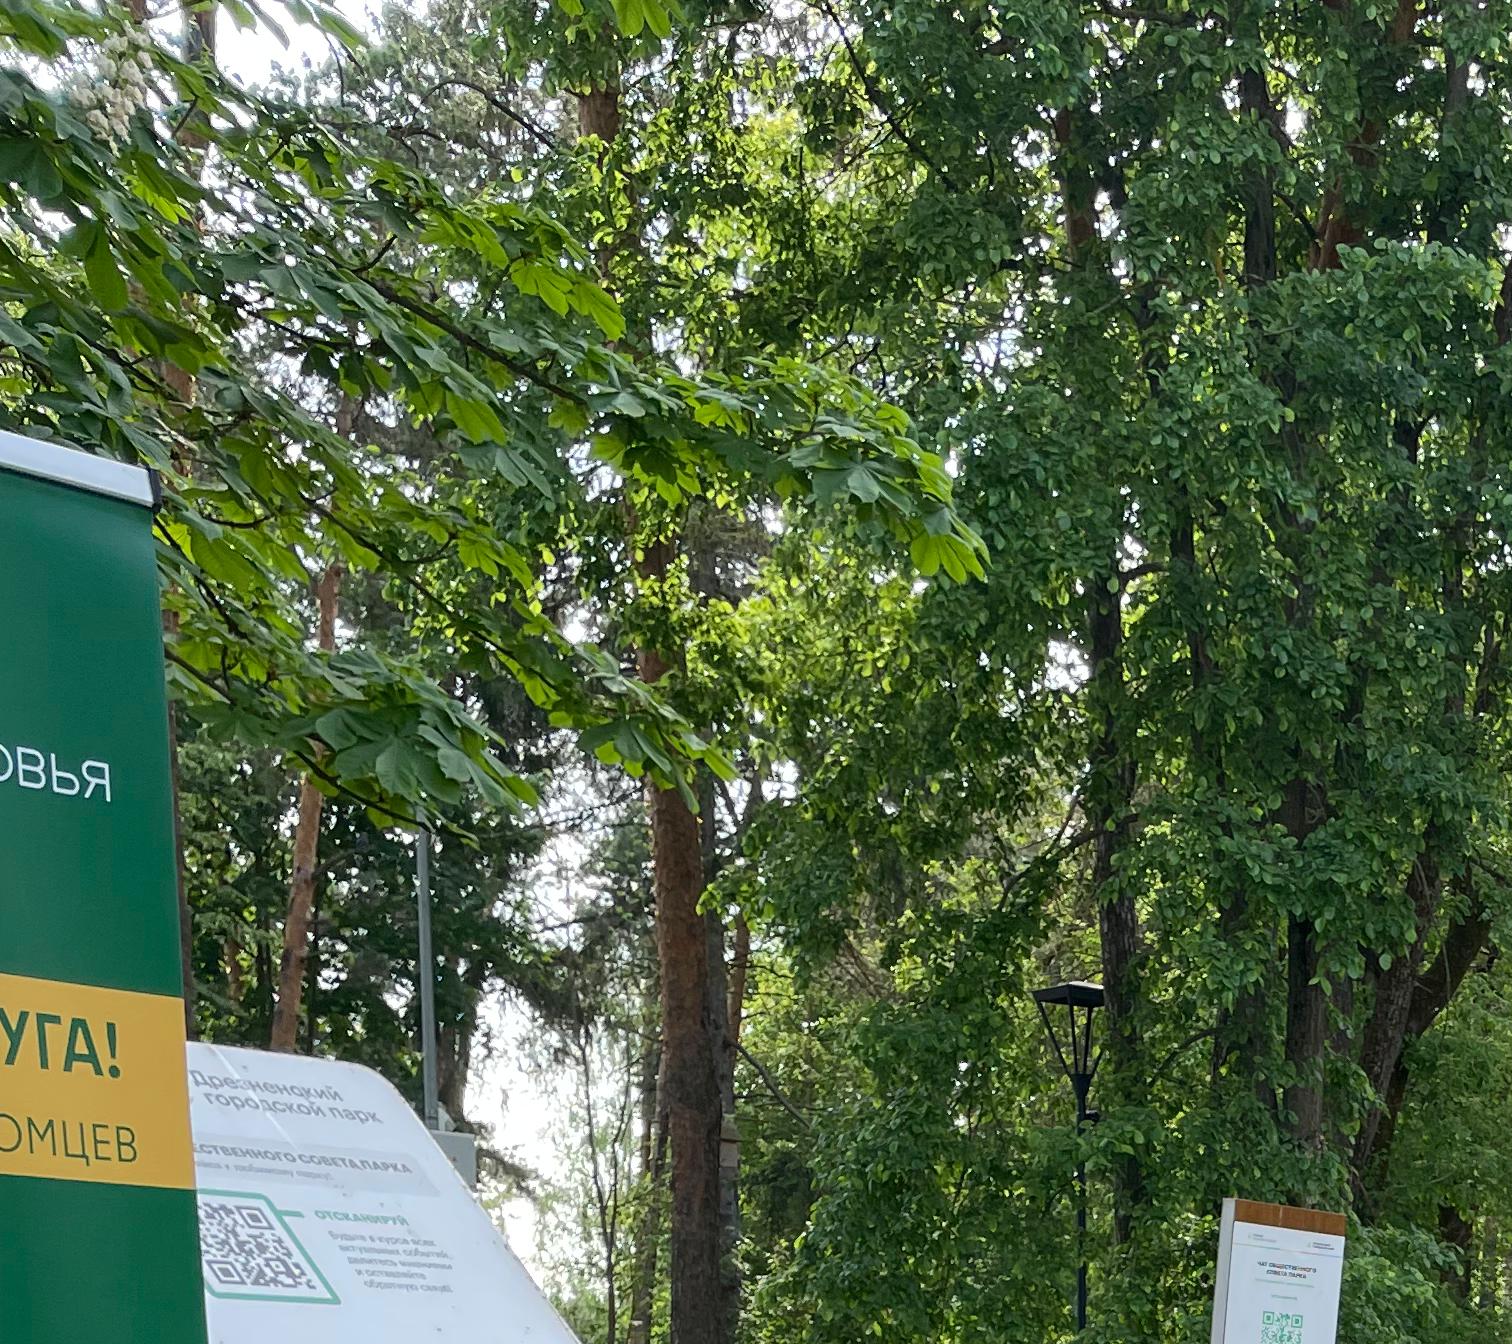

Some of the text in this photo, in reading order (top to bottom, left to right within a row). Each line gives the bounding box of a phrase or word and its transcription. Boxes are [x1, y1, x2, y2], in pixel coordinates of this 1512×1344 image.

[203, 1092, 384, 1125] городской парк
[362, 1159, 413, 1175] ПАРКА
